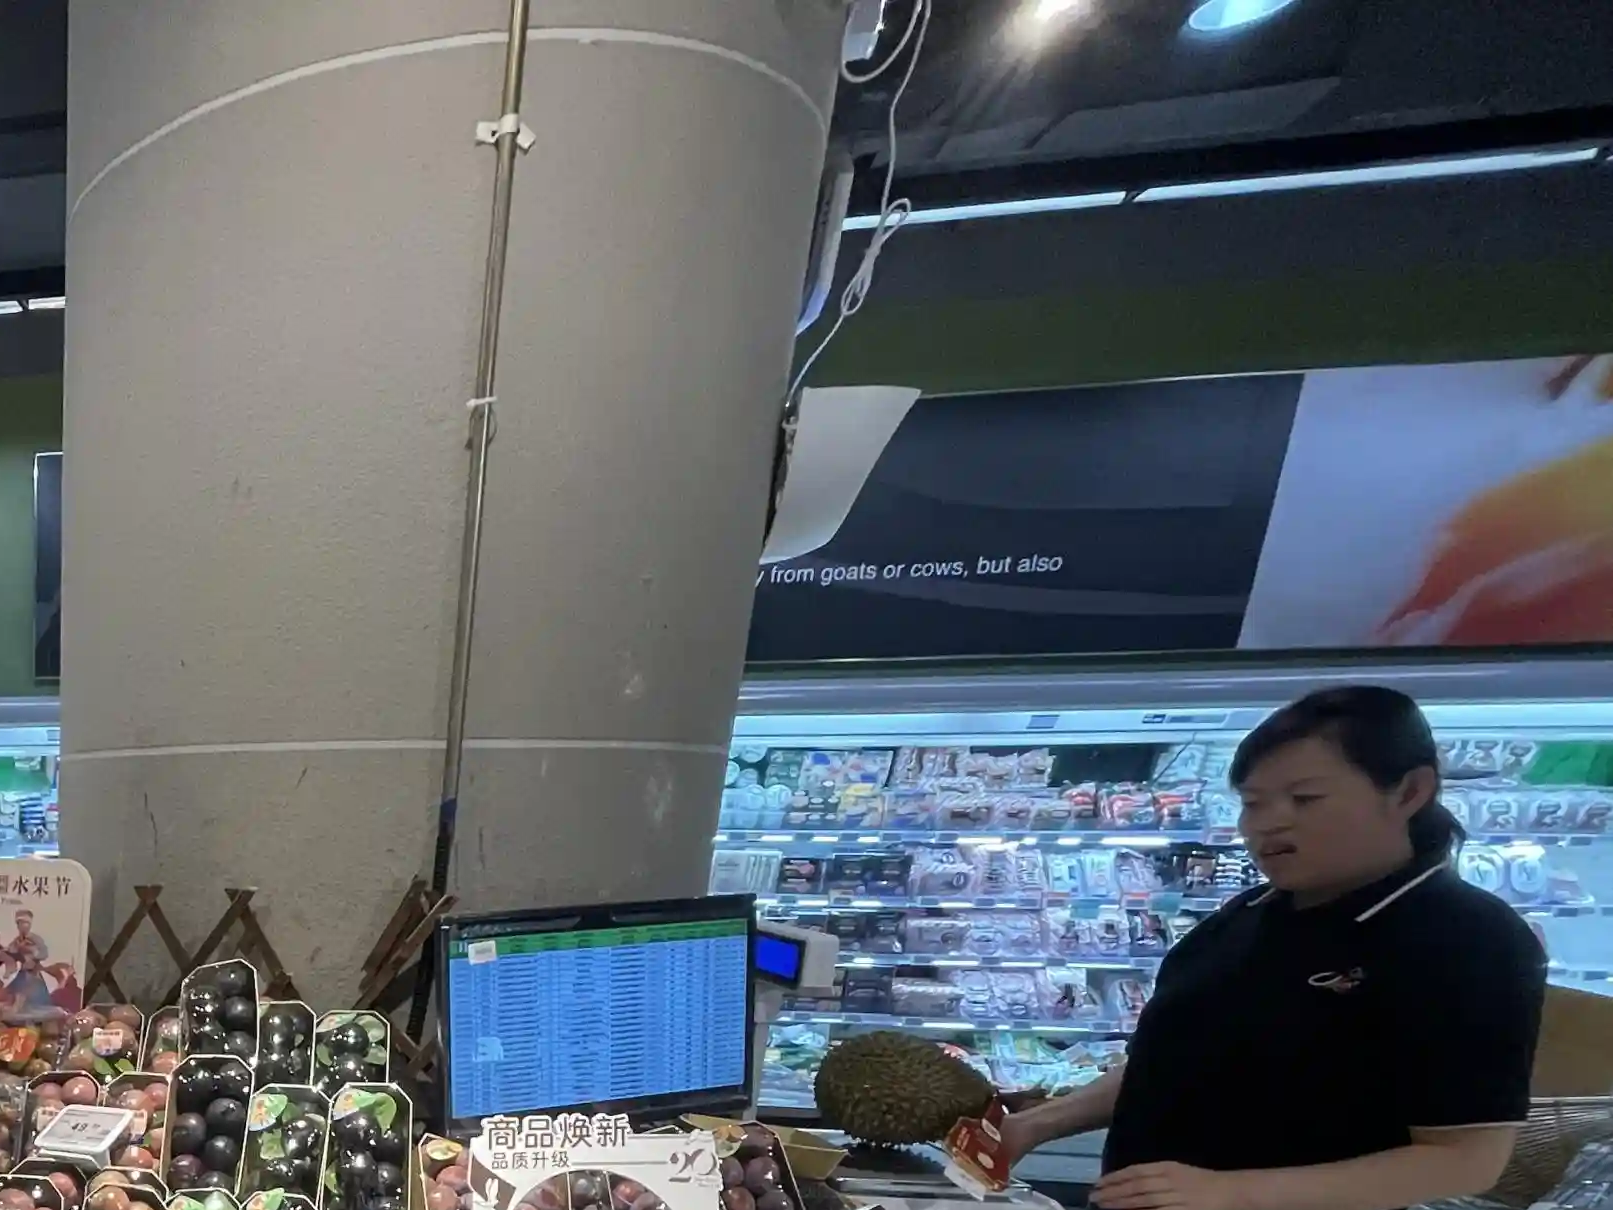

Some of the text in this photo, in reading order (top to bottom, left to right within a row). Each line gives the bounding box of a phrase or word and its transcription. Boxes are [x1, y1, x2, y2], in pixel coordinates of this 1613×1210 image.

[771, 566, 814, 584] from
[820, 561, 876, 587] goats
[883, 561, 903, 579] or
[910, 557, 969, 579] cows,
[977, 555, 1012, 574] but
[1017, 553, 1063, 573] also
[487, 1115, 629, 1150] 商品焕新
[492, 1151, 570, 1169] 品质升级
